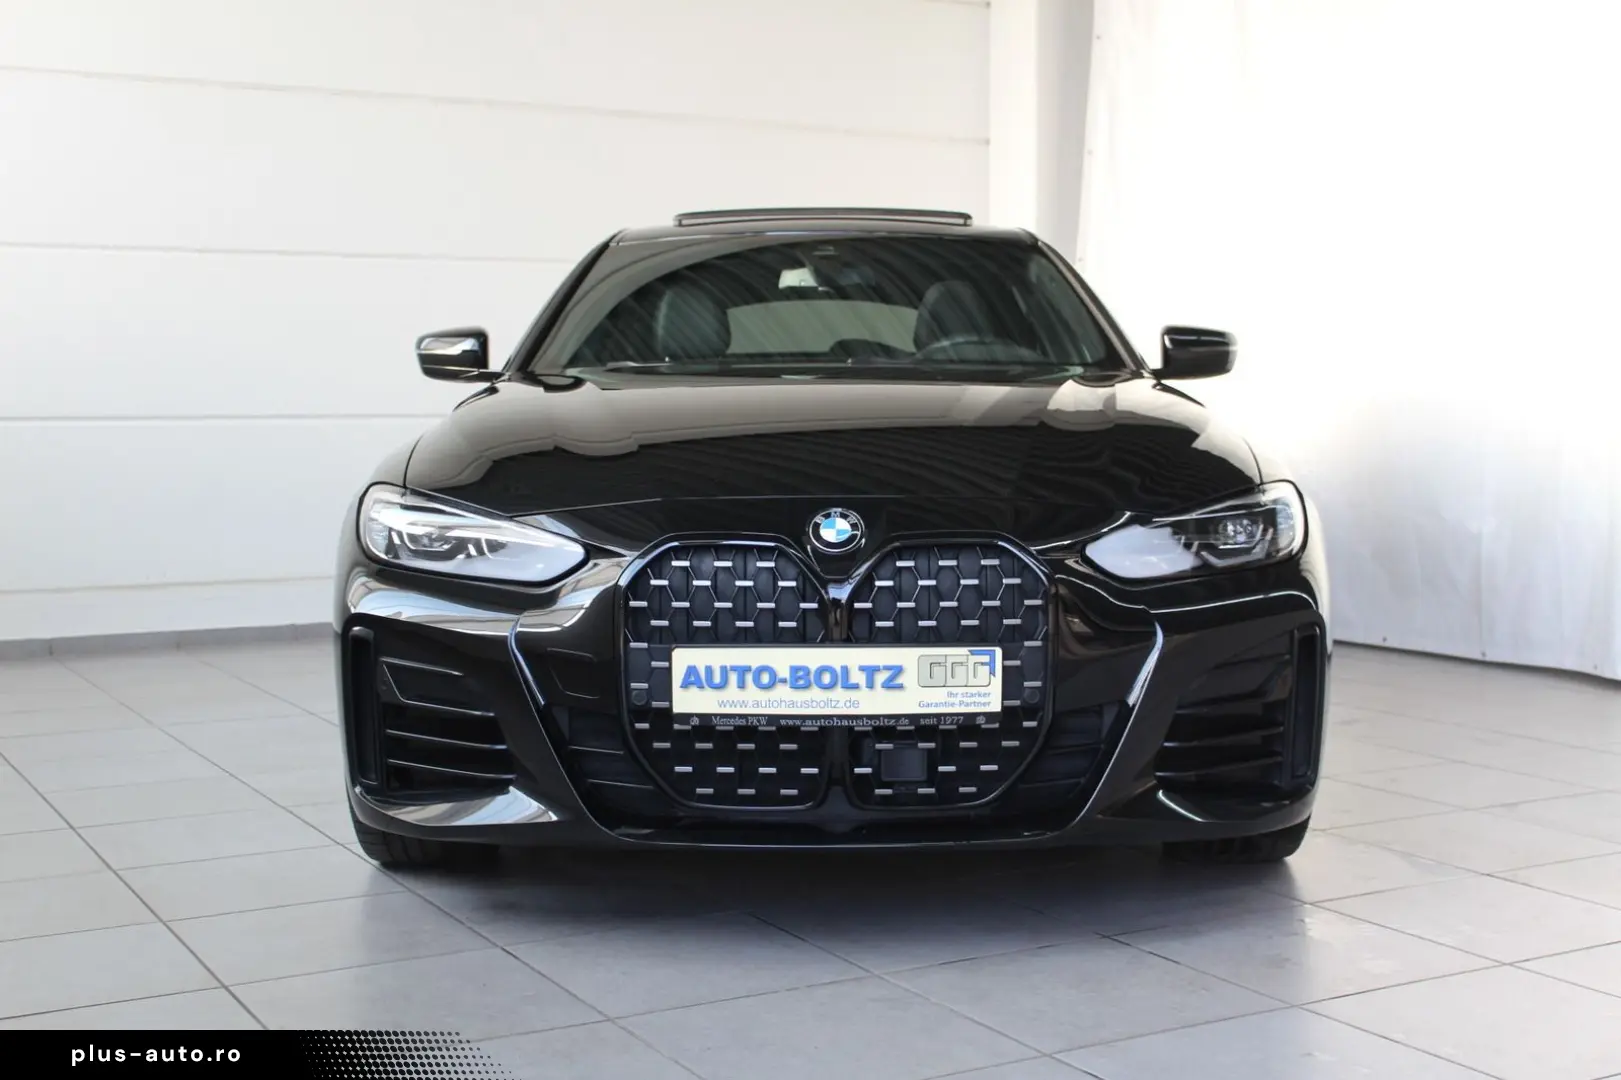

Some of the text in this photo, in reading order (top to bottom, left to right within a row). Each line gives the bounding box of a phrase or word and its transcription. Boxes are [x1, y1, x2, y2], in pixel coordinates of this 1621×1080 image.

[679, 664, 904, 690] AUTO-BOLTZ
[717, 696, 860, 710] www.autohausboltz.de
[918, 700, 992, 708] Garantie-Partner
[711, 716, 964, 727] Mercedes PKW www.autohausboltz.de seit 1977
